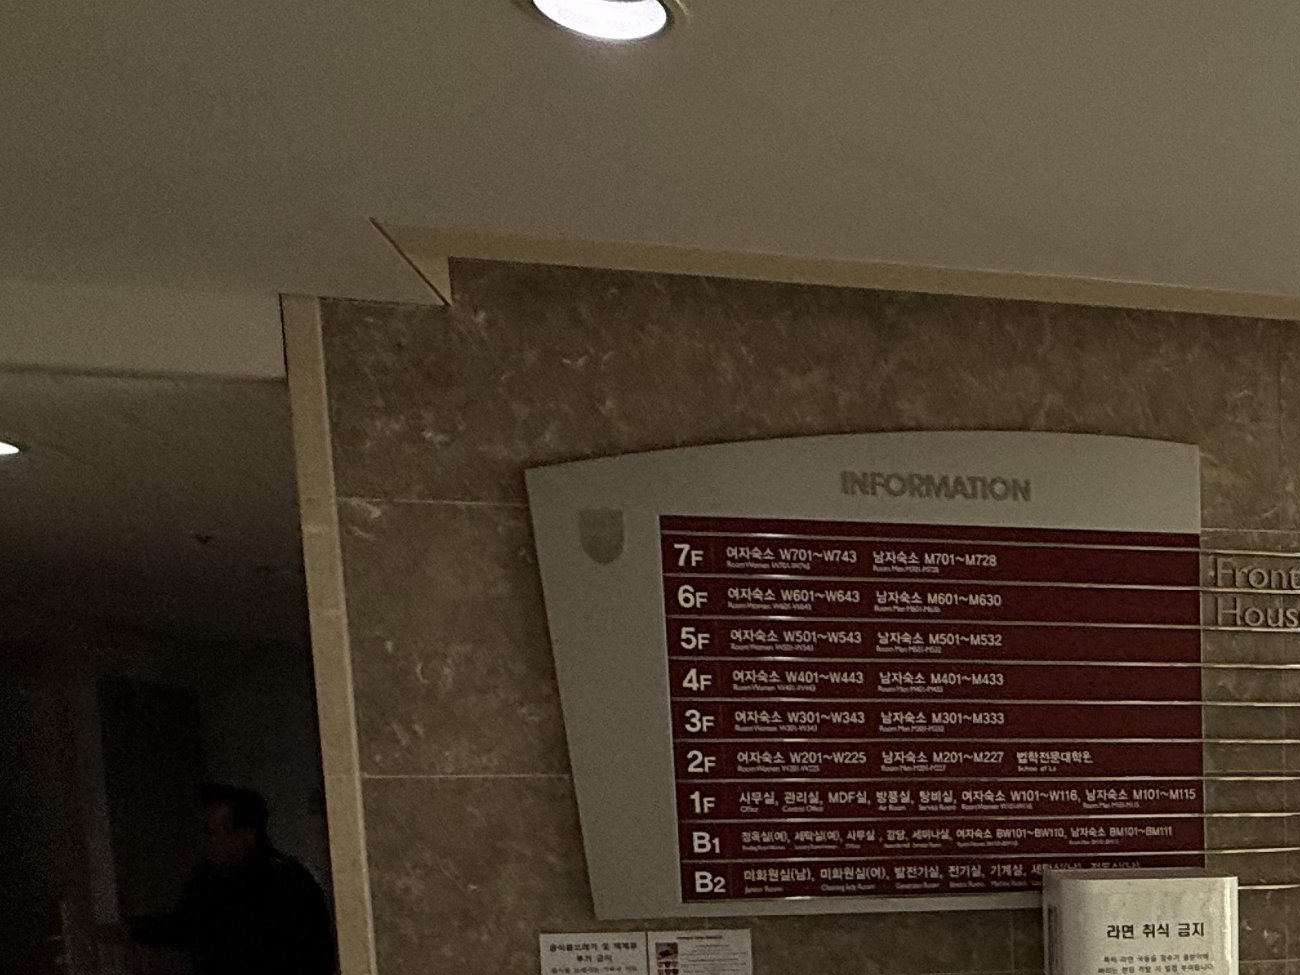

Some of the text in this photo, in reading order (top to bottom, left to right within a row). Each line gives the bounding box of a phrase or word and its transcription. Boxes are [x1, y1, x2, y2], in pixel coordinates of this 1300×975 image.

[840, 470, 1031, 501] INFORMATION
[673, 544, 997, 567] 7F 여자숙소 W701~W743 남자숙소 M701~M728
[677, 584, 1002, 609] 6F 여자숙소 W601~W643 남자숙소 M601~M630
[680, 627, 1002, 651] 5F 여자숙소 W501~W543 남자숙소 M501~M532
[682, 668, 1004, 691] 4F 여자숙소 W401~W443 남자숙소 M401~M433
[685, 709, 1004, 733] 3F 여자숙소 W301~W343 남자숙소 M301~M333
[686, 750, 716, 773] 2F
[737, 751, 785, 765] 여자숙소
[790, 751, 866, 764] W201~W225
[882, 751, 928, 764] 남자숙소
[933, 751, 1004, 764] M201~M227
[690, 791, 715, 813] 1F
[739, 792, 778, 806] 사무실,
[784, 792, 823, 805] 관리실,
[961, 789, 1005, 803] 여자숙소
[1086, 789, 1128, 801] 남자숙소
[1133, 789, 1196, 801] M101~M115
[692, 832, 720, 853] B1
[956, 828, 991, 840] 여자숙소
[1070, 827, 1105, 838] 남자숙소
[695, 871, 726, 893] B2
[1107, 922, 1204, 939] 라면 취식 금지
